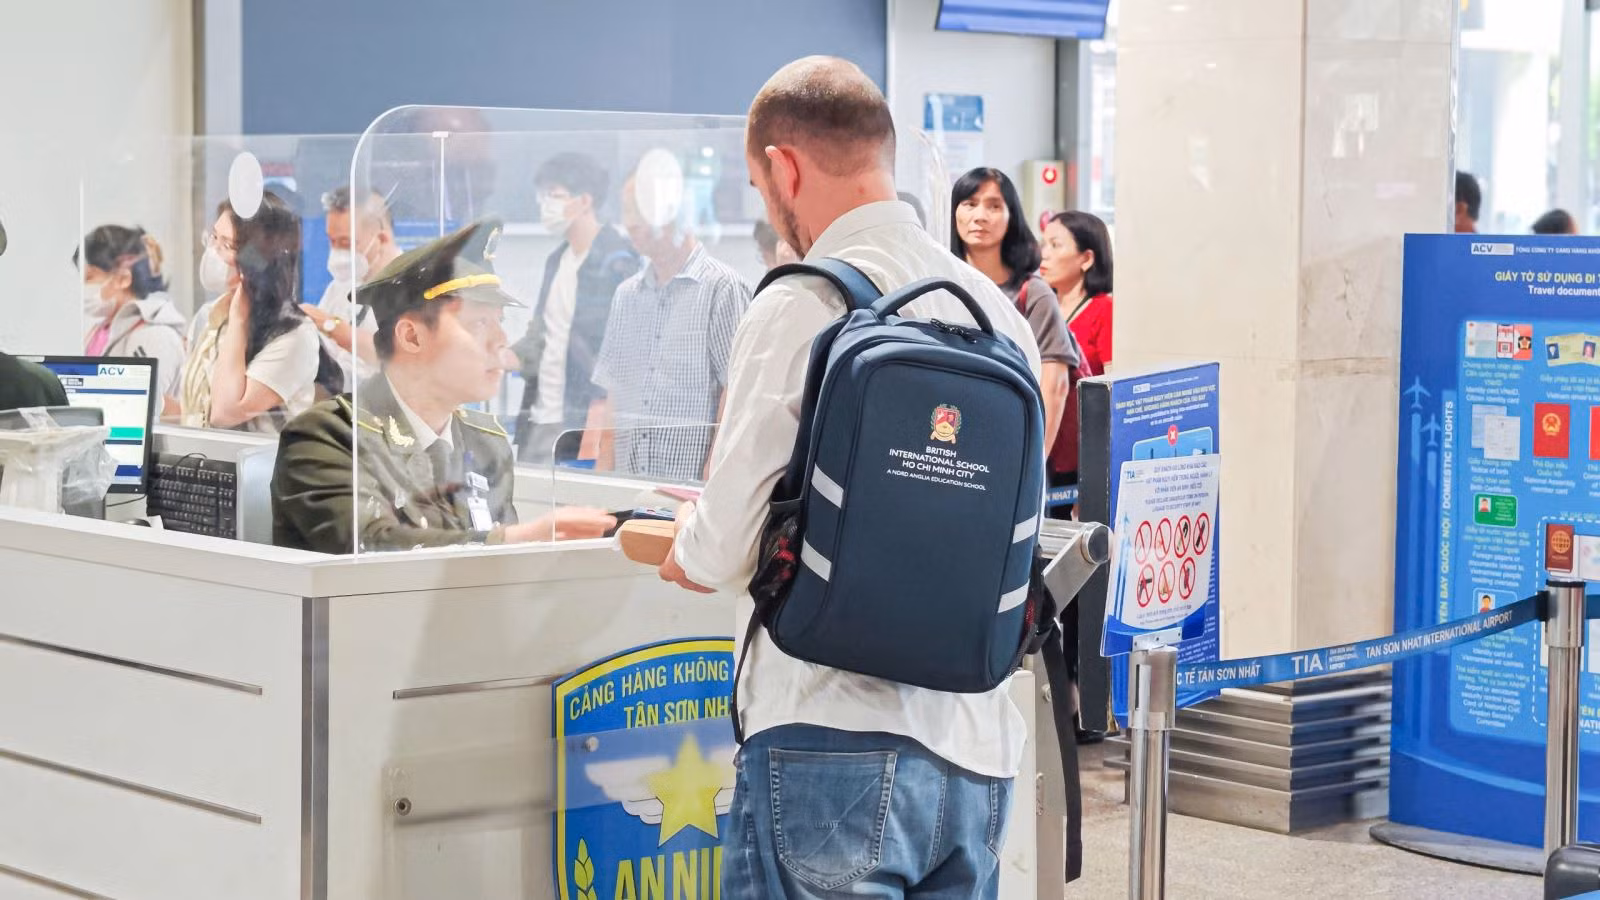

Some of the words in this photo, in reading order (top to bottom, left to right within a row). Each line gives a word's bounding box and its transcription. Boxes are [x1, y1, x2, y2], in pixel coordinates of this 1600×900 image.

[1494, 270, 1518, 281] GIẤY
[1521, 270, 1535, 282] TỜ
[1554, 273, 1582, 285] DỤNG
[1585, 273, 1595, 284] ĐI
[1528, 285, 1554, 295] Travel
[1557, 286, 1600, 296] document
[100, 367, 125, 376] ACV
[1444, 401, 1453, 448] FLIGHTS
[889, 448, 954, 467] INTERNATIONAL
[956, 460, 990, 473] SCHOOL
[926, 446, 957, 457] BRITISH
[902, 460, 915, 469] HO
[917, 462, 931, 471] CHI
[932, 465, 955, 476] MINH
[956, 470, 975, 479] CITY
[1127, 471, 1135, 479] TIA
[1442, 452, 1451, 509] DOMESTIC
[931, 476, 963, 486] EDUCATION
[964, 482, 986, 490] SCHOOL
[1440, 576, 1448, 598] BAY
[1366, 645, 1381, 658] TAN
[1383, 642, 1400, 655] SON
[1401, 636, 1422, 651] NHAT
[1424, 622, 1482, 646] INTERNATIONAL
[1483, 610, 1512, 629] AIRPORT
[1185, 667, 1196, 685] TẾ
[1198, 667, 1214, 683] TÂN
[1216, 666, 1236, 680] SƠN
[1238, 660, 1261, 679] NHẤT
[1291, 653, 1323, 674] TIA
[570, 681, 614, 720] CẢNG
[622, 665, 667, 697] HÀNG
[674, 656, 728, 684] KHÔNG
[624, 701, 658, 728] TÂN
[664, 698, 698, 724] SƠN
[704, 696, 731, 719] NH
[614, 854, 664, 900] AN
[672, 846, 722, 900] NI
